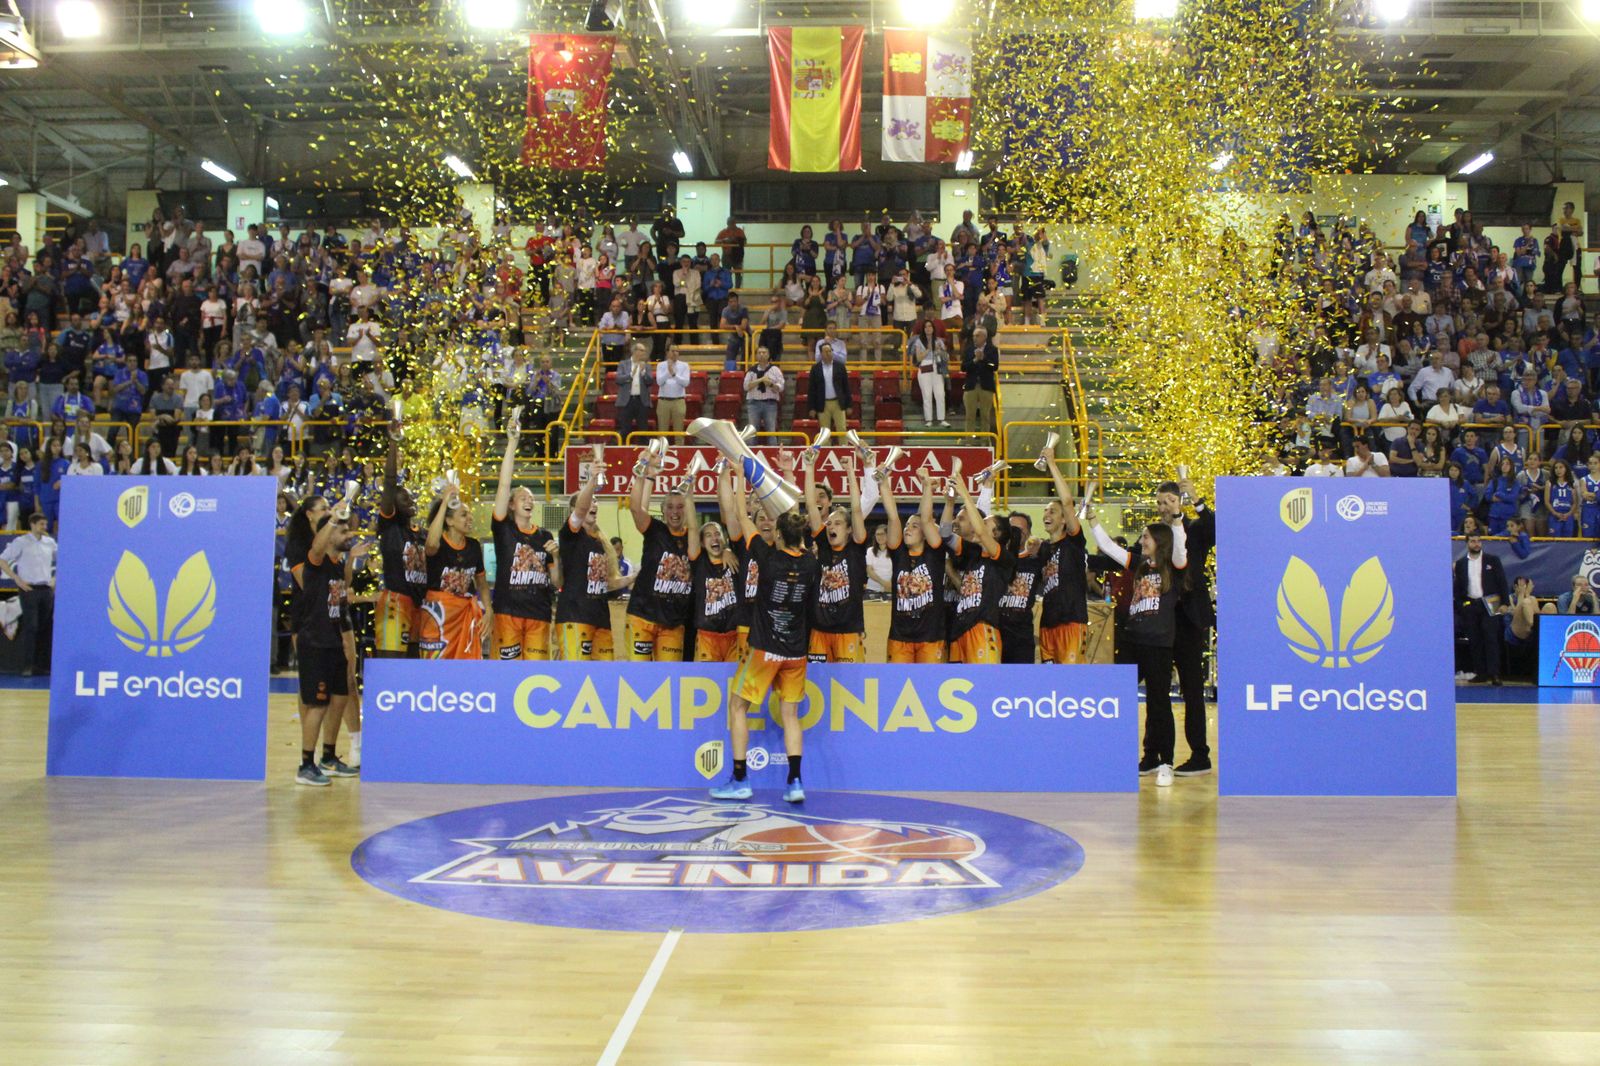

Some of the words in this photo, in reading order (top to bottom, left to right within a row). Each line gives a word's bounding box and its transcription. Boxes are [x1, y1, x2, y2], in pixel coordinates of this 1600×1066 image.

[124, 495, 142, 520] 100
[1286, 497, 1306, 524] 100
[76, 671, 118, 696] LF
[124, 671, 242, 698] endesa
[1246, 684, 1293, 710] LF
[1300, 682, 1427, 710] endesa
[376, 685, 496, 713] endesa
[991, 690, 1119, 718] endesa
[701, 748, 718, 772] 100
[446, 857, 968, 885] AVENIDA
